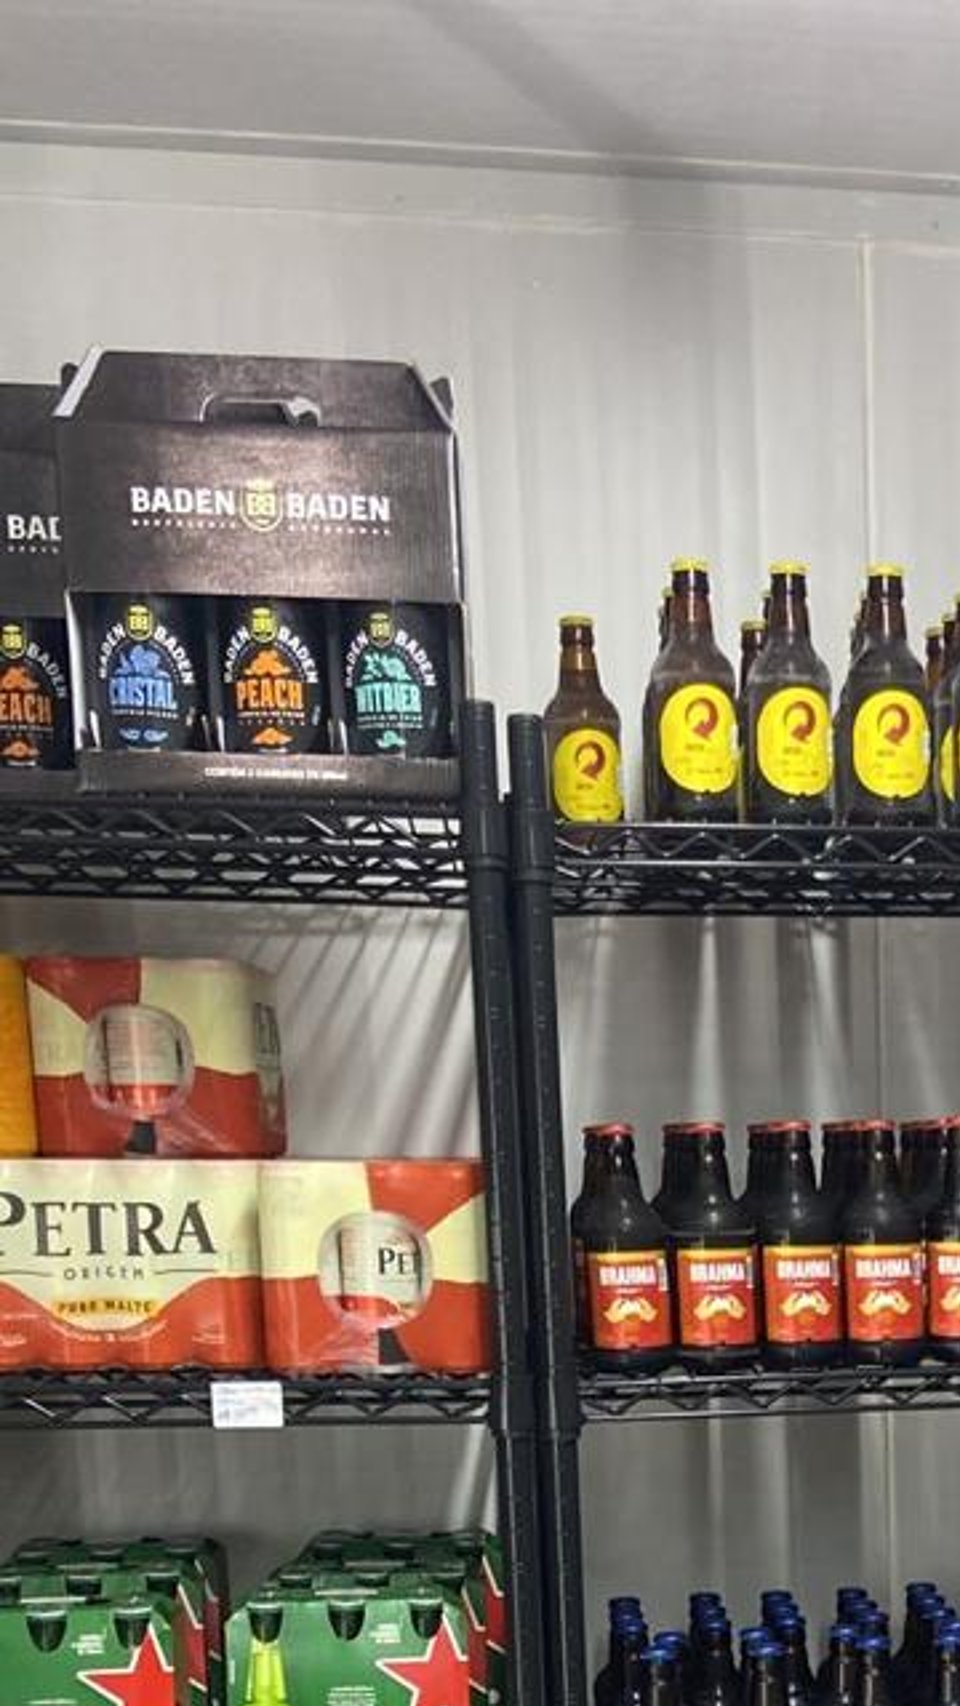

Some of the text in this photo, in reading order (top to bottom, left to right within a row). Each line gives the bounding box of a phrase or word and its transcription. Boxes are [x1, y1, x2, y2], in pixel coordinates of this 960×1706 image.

[130, 485, 235, 516] BADEN
[286, 492, 391, 522] BADEN
[154, 624, 195, 685] BADEN
[278, 626, 319, 684] BADEN
[394, 629, 437, 687] BADEN
[236, 676, 305, 711] PEACH
[600, 1265, 657, 1286] BRAHMA
[690, 1262, 745, 1283] BRAHMA
[777, 1260, 832, 1278] BRAHMA
[855, 1258, 912, 1279] BRAHMA
